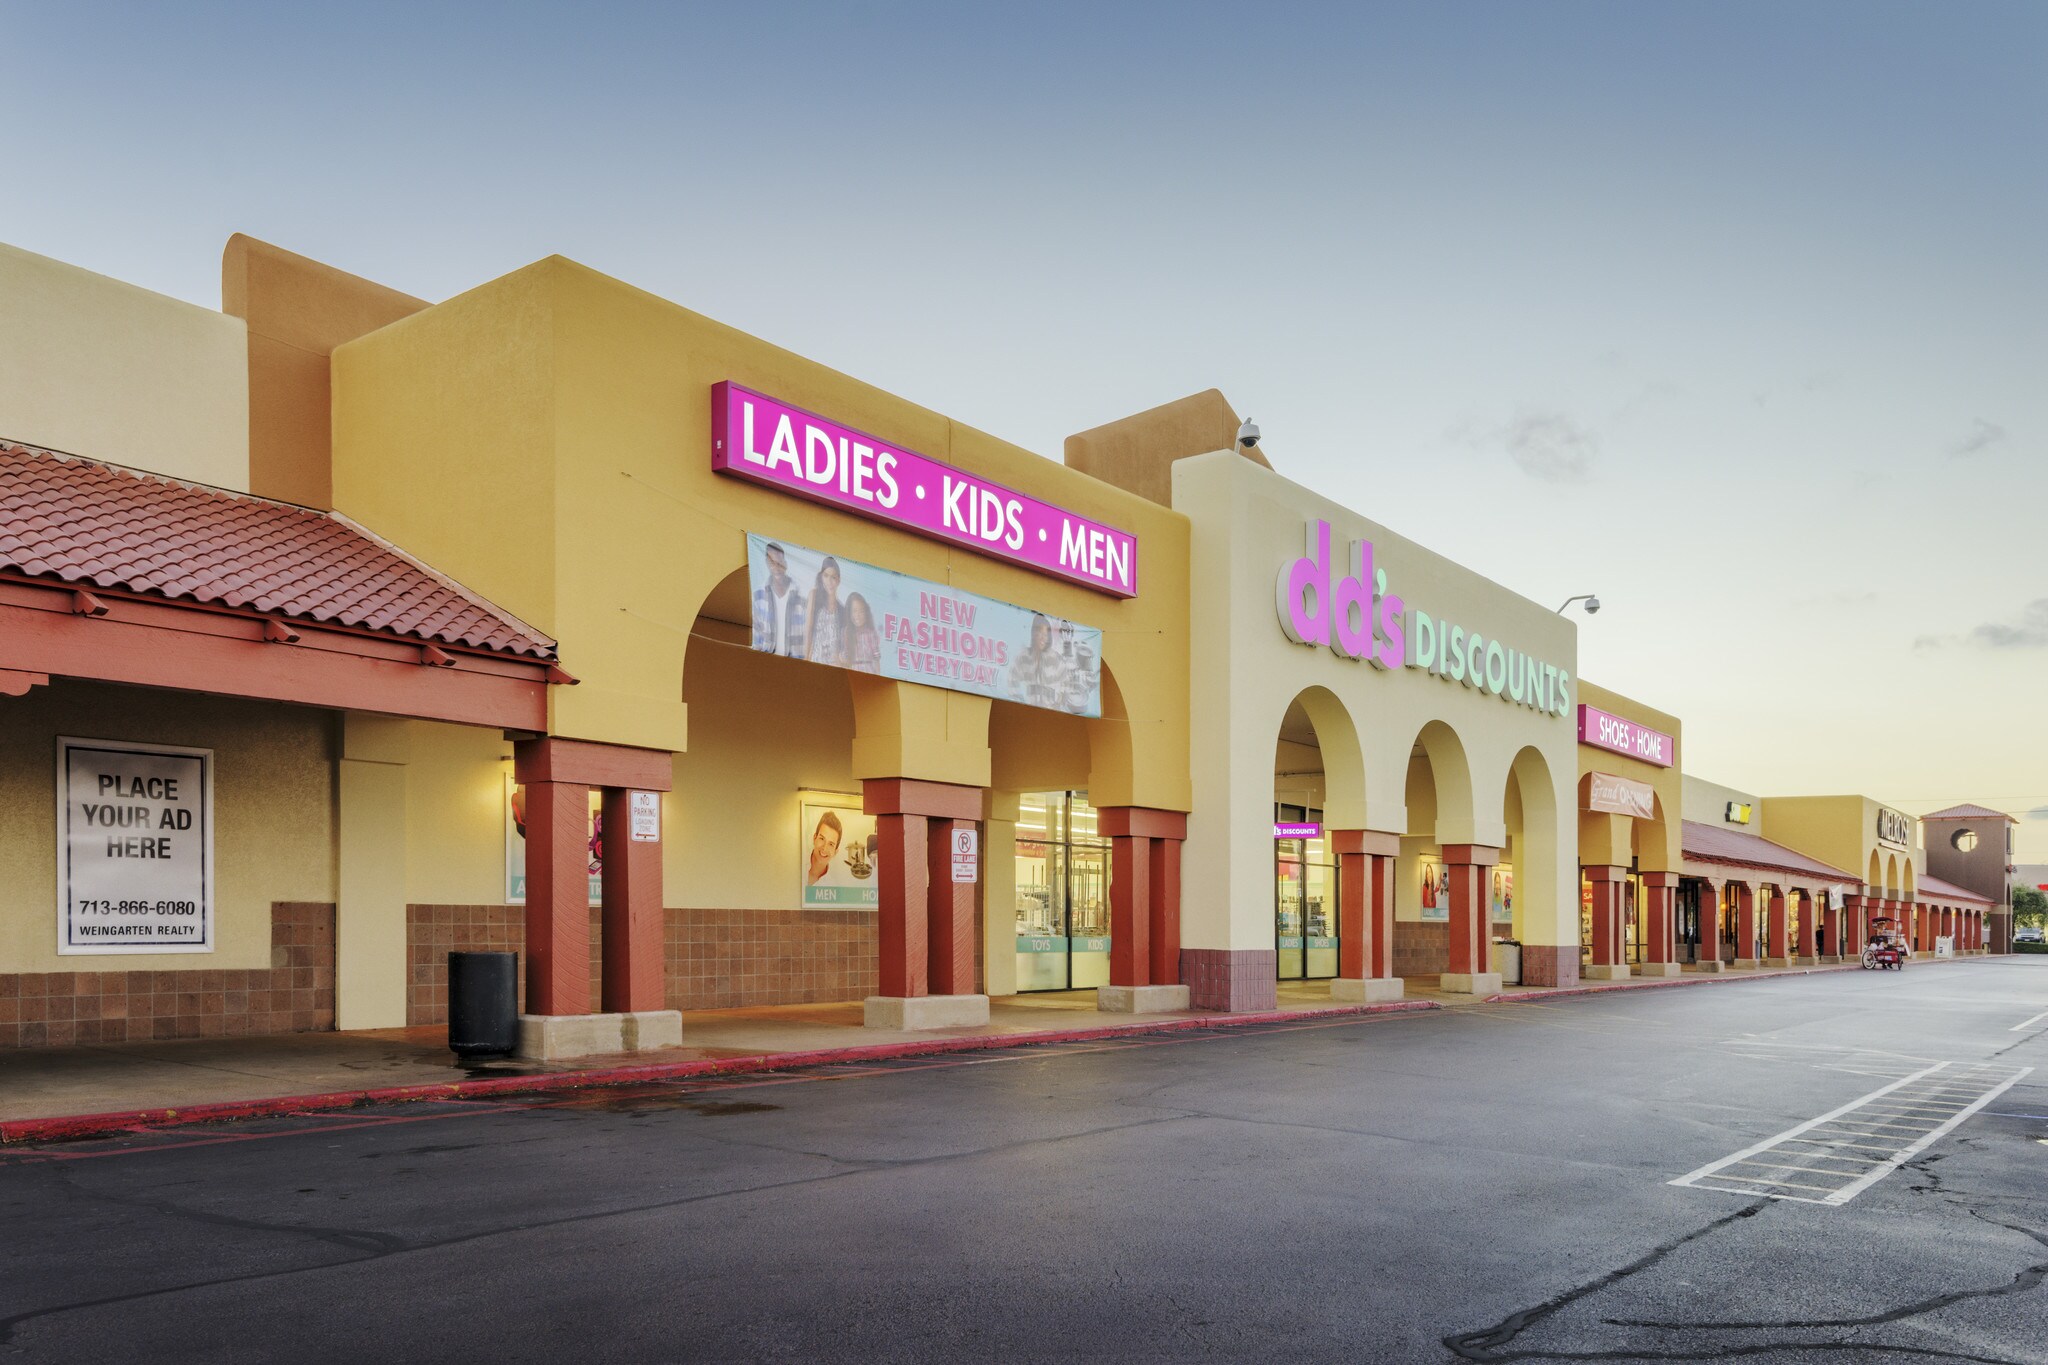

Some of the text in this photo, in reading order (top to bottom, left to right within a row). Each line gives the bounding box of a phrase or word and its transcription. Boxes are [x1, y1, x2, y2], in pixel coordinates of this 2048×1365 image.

[744, 401, 1129, 587] LADIES KIDS MEN
[920, 591, 976, 629] NEW
[1286, 518, 1570, 718] dd's DISCOUNTS
[884, 613, 1009, 666] FASHIONS
[897, 647, 999, 686] EVERYDAY
[1599, 716, 1662, 760] SHOES HOME
[98, 774, 178, 801] PLACE
[1592, 780, 1619, 803] Grand
[633, 806, 656, 818] PARKING
[640, 796, 650, 806] NO
[82, 803, 192, 831] YOUR AD
[107, 836, 171, 859] HERE
[815, 888, 879, 901] MEN HO
[79, 900, 195, 916] 713-866-6080
[80, 925, 195, 936] WEINGARTEN REALTY
[1031, 939, 1051, 951] TOYS
[1087, 939, 1104, 951] KIDS
